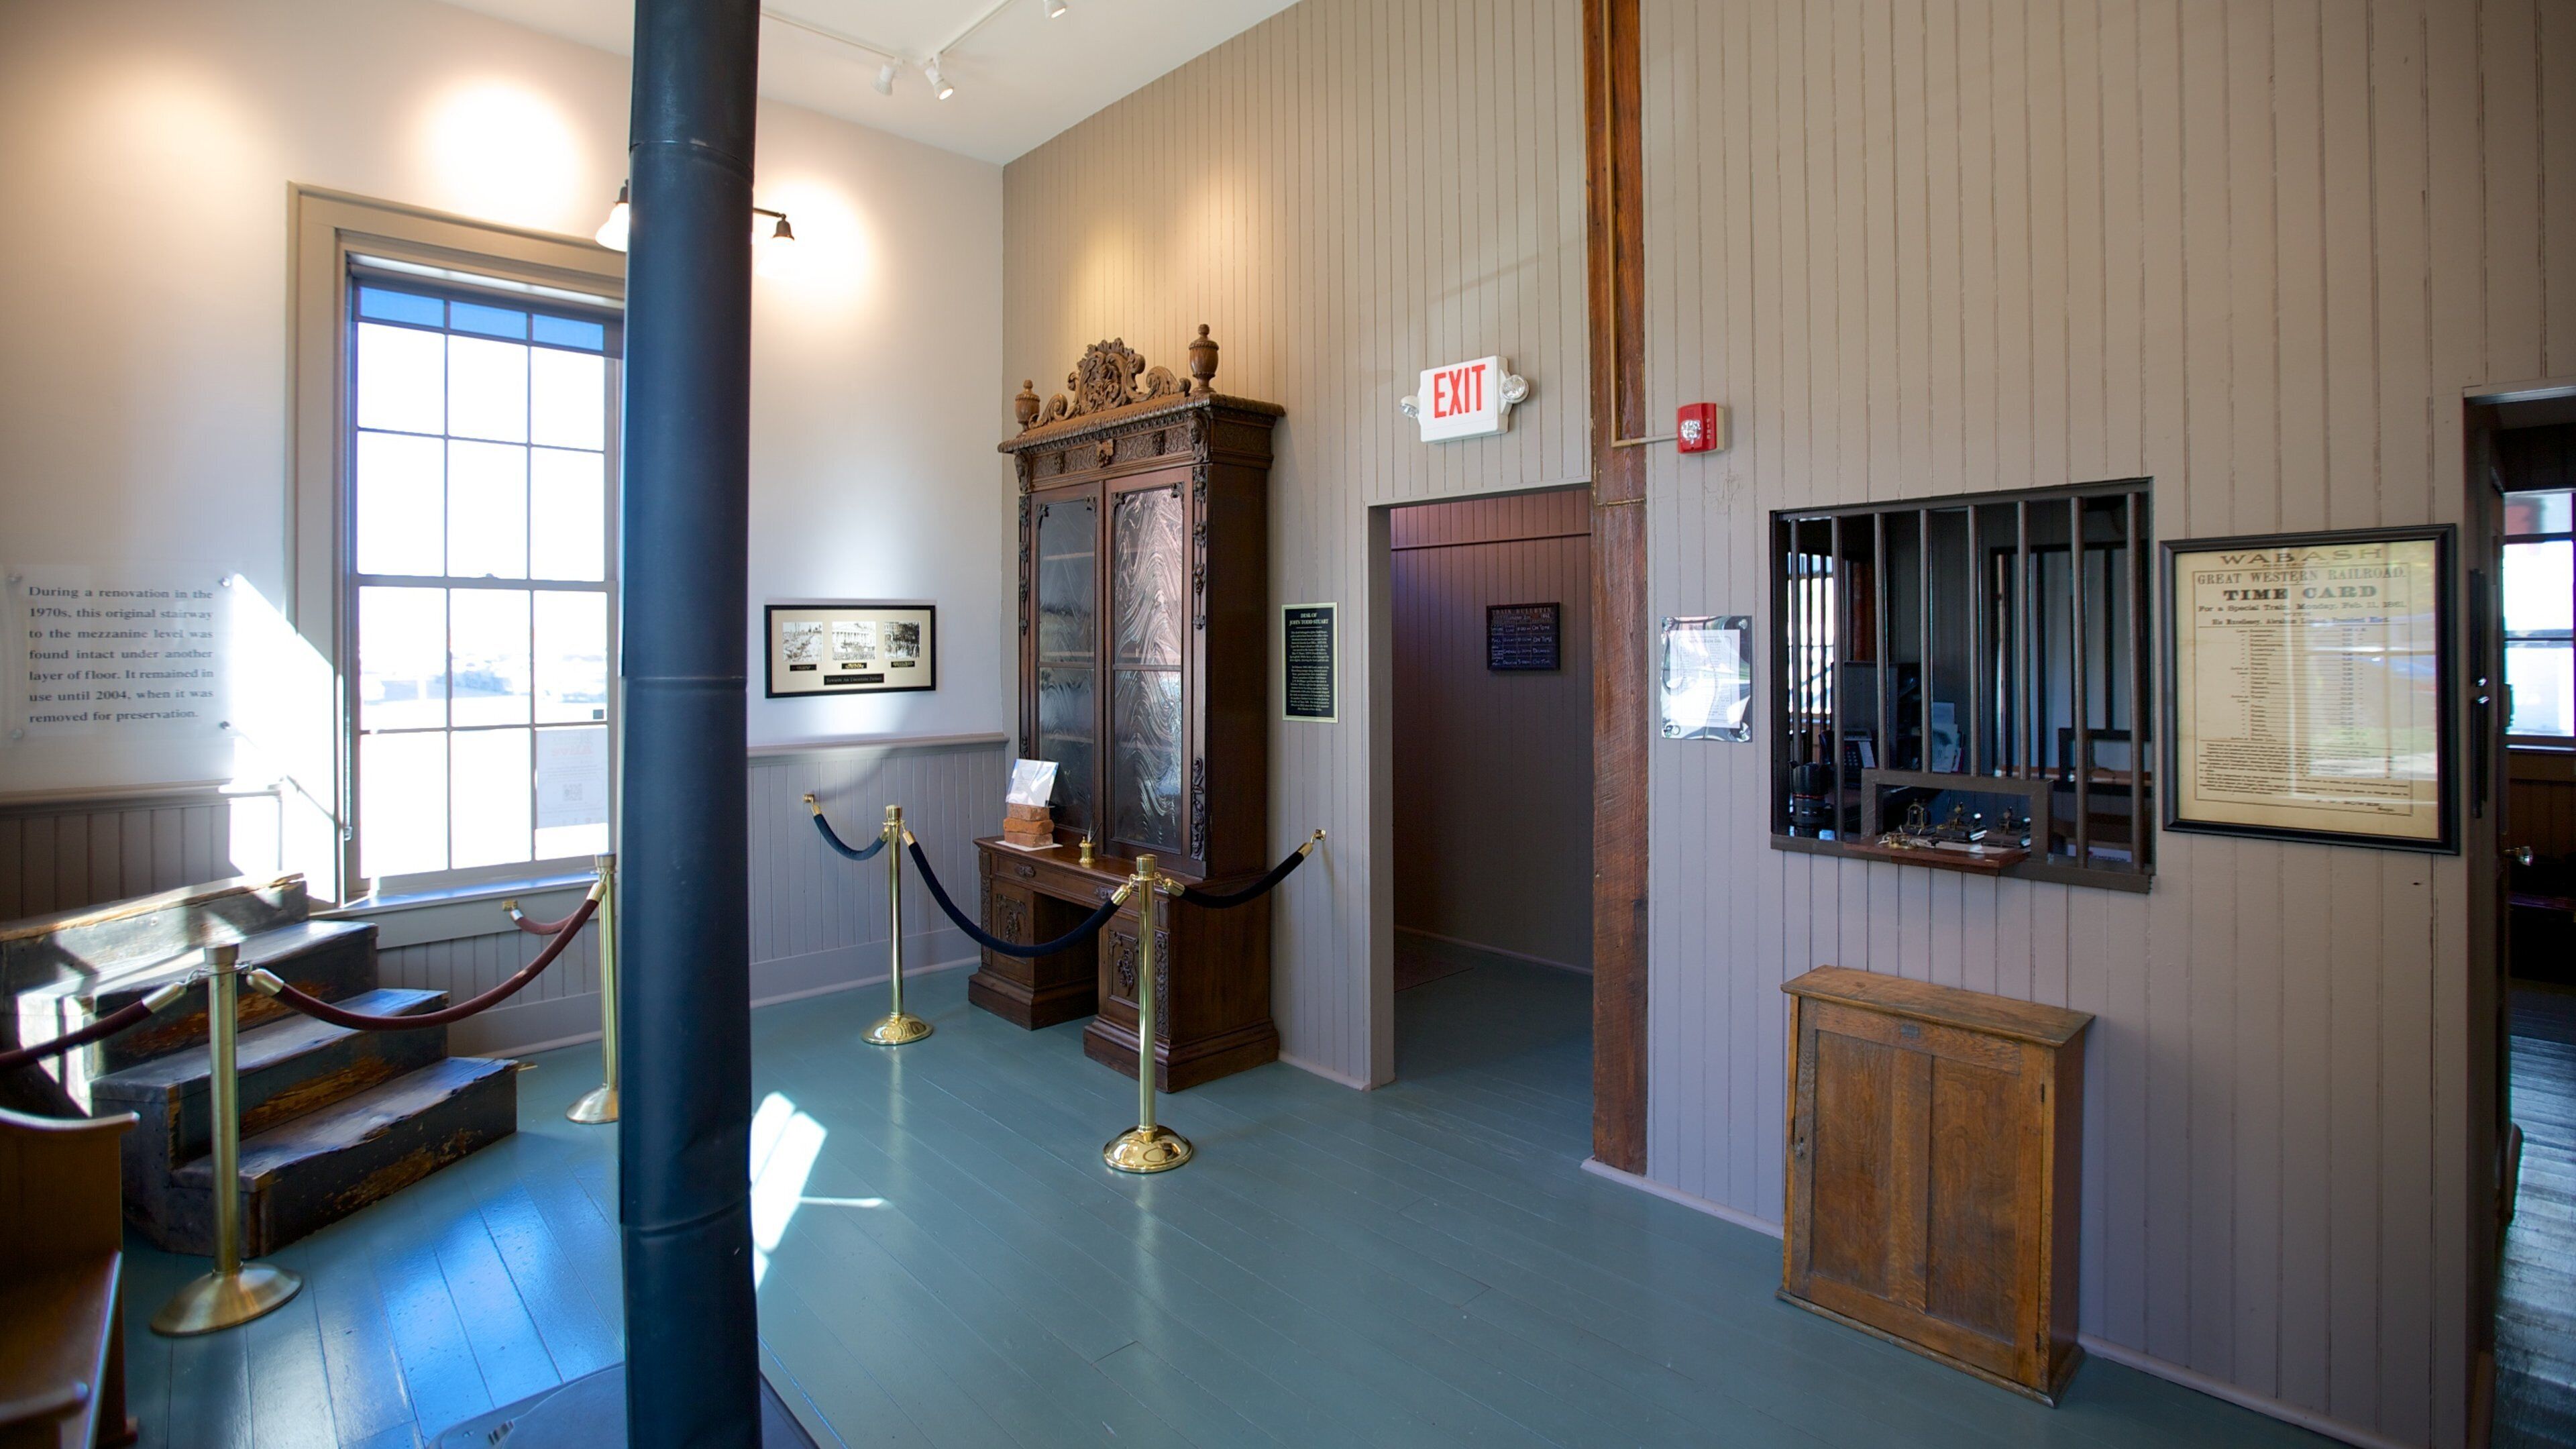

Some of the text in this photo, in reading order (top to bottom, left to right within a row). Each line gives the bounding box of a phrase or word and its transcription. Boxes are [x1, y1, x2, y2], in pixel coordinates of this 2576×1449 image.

[1433, 364, 1487, 419] EXIT
[2220, 548, 2383, 565] WABASH
[2198, 566, 2406, 585] GREAT WESTERN RAILROAD.
[29, 586, 78, 599] During
[99, 589, 170, 598] renovation
[174, 590, 188, 598] in
[193, 590, 213, 599] the
[2223, 585, 2377, 601] TIME CARD
[30, 608, 213, 621] 1970s, this original stairway
[2228, 604, 2259, 612] Special
[29, 630, 42, 638] to
[50, 629, 71, 638] the
[78, 629, 148, 638] mezzanine
[154, 629, 184, 638] level
[29, 649, 214, 659] found intact under another
[29, 669, 214, 683] layer of floor. It remained in
[29, 694, 52, 702] use
[58, 691, 90, 701] until
[95, 690, 131, 700] 2004,
[136, 690, 170, 698] when
[175, 690, 185, 698] it
[29, 709, 199, 723] removed for preservation.
